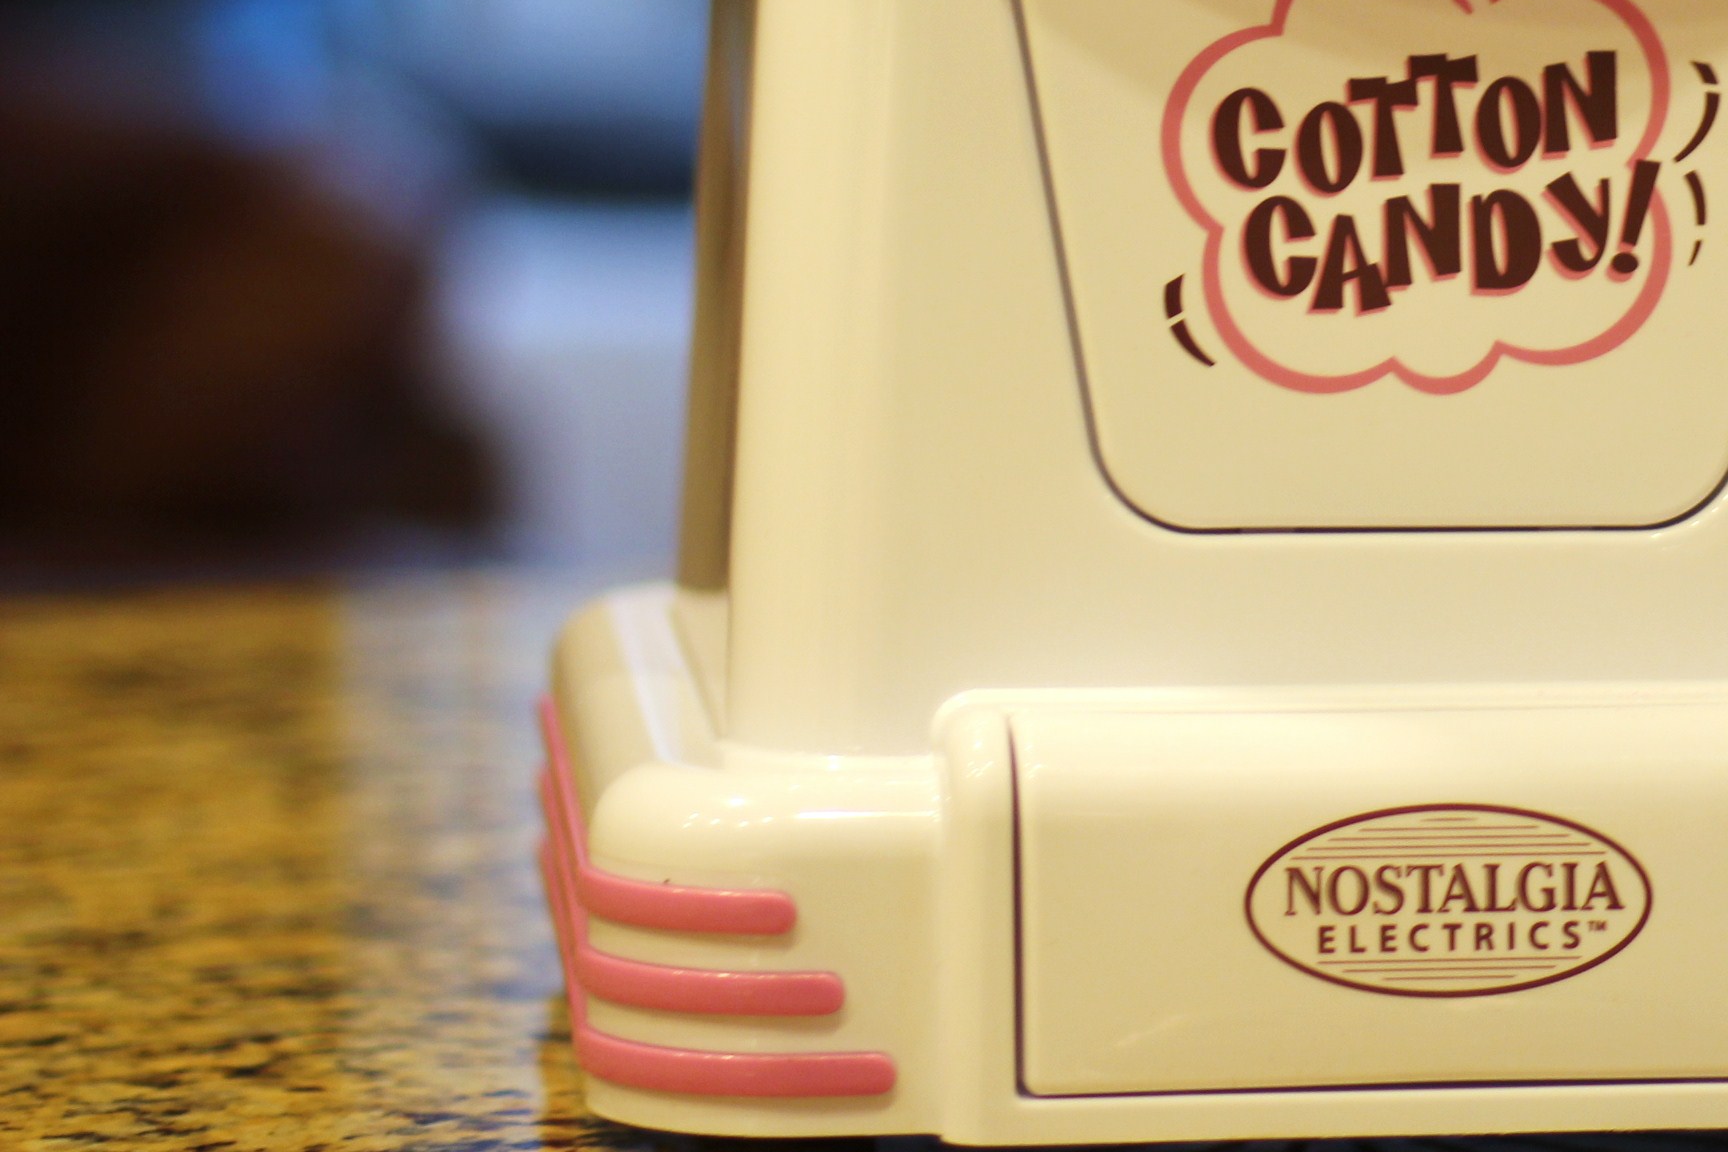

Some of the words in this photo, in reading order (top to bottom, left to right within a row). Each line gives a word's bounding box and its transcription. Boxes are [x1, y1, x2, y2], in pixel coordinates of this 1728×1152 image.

[1211, 50, 1619, 196] COTTON
[1239, 160, 1662, 316] CANDY!
[1284, 860, 1625, 917] NOSTALGIA
